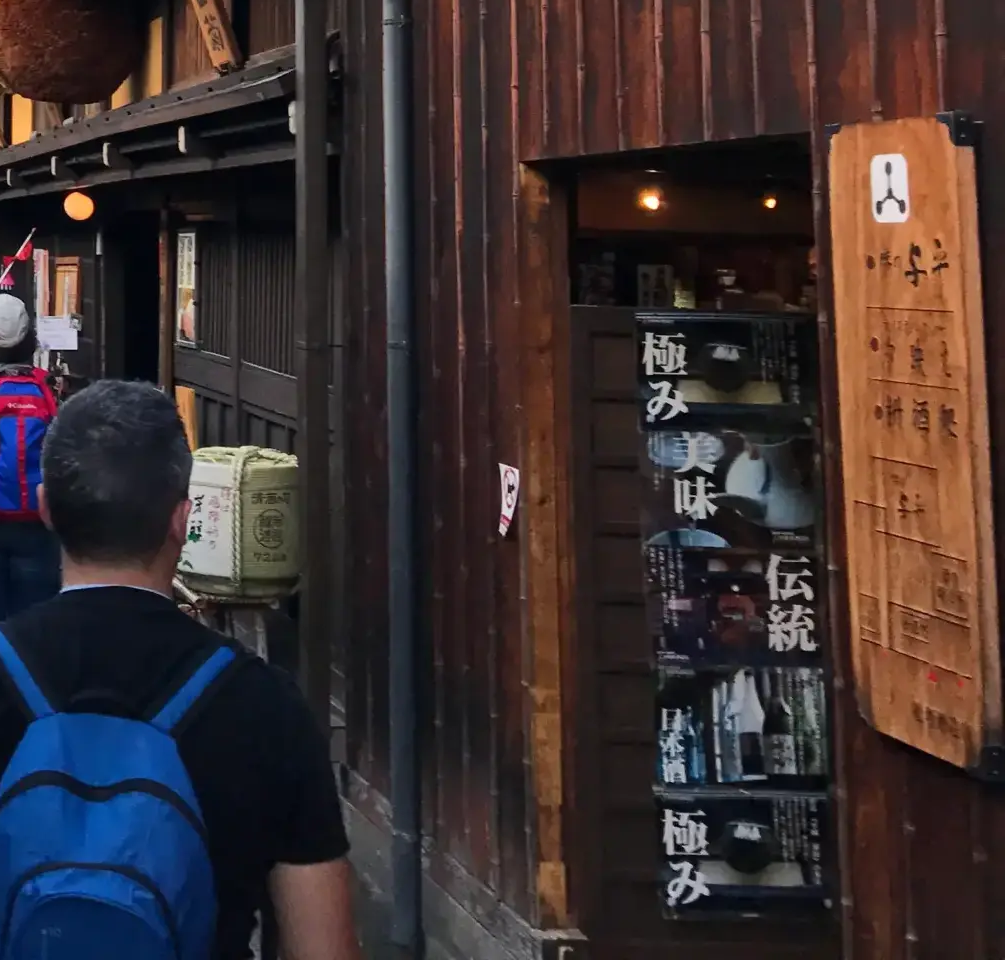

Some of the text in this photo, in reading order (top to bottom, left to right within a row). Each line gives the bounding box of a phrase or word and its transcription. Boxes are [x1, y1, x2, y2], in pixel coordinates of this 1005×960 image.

[642, 331, 689, 422] 極み
[673, 431, 719, 520] 美味
[764, 552, 819, 653] 伝統
[661, 808, 711, 907] 極み
